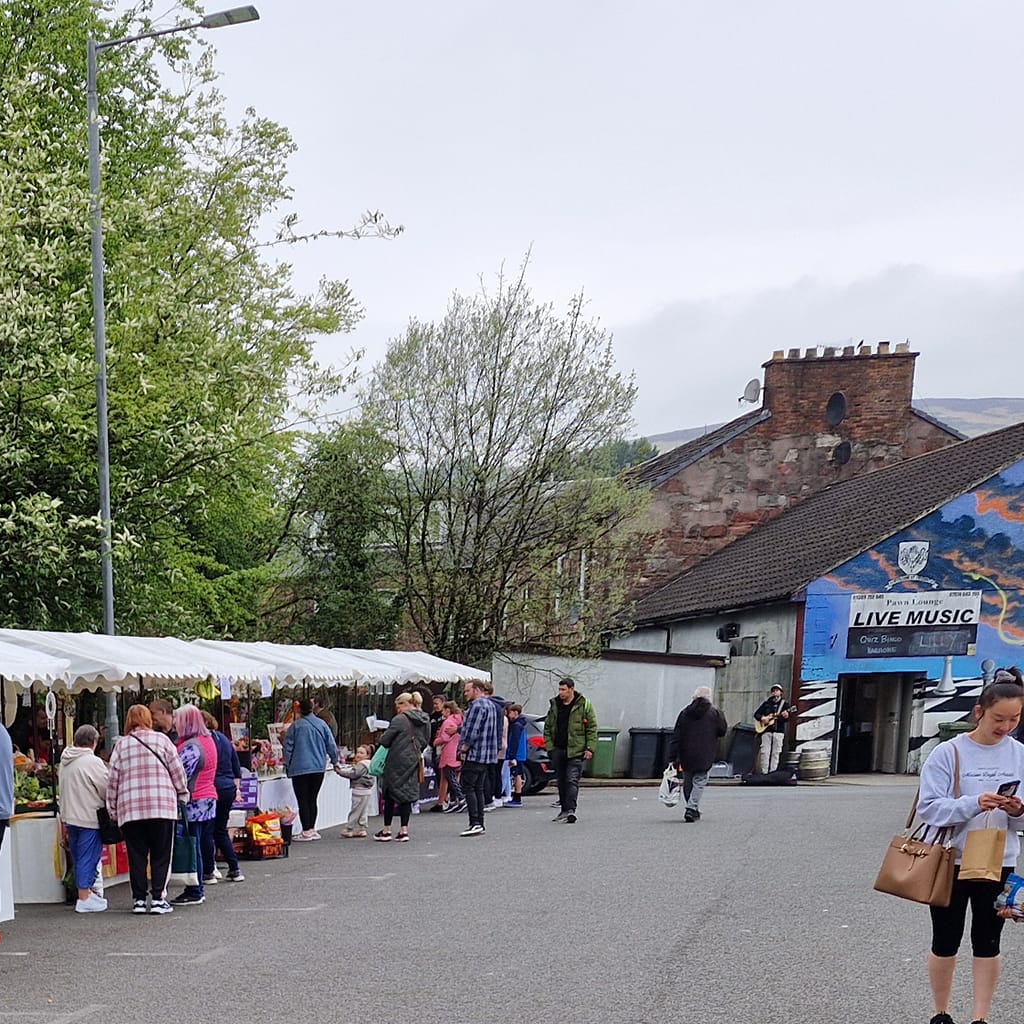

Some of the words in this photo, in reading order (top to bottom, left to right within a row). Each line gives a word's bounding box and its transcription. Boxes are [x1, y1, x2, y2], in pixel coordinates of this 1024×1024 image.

[912, 598, 944, 606] Lounge
[853, 611, 902, 627] LIVE
[906, 609, 975, 625] MUSIC
